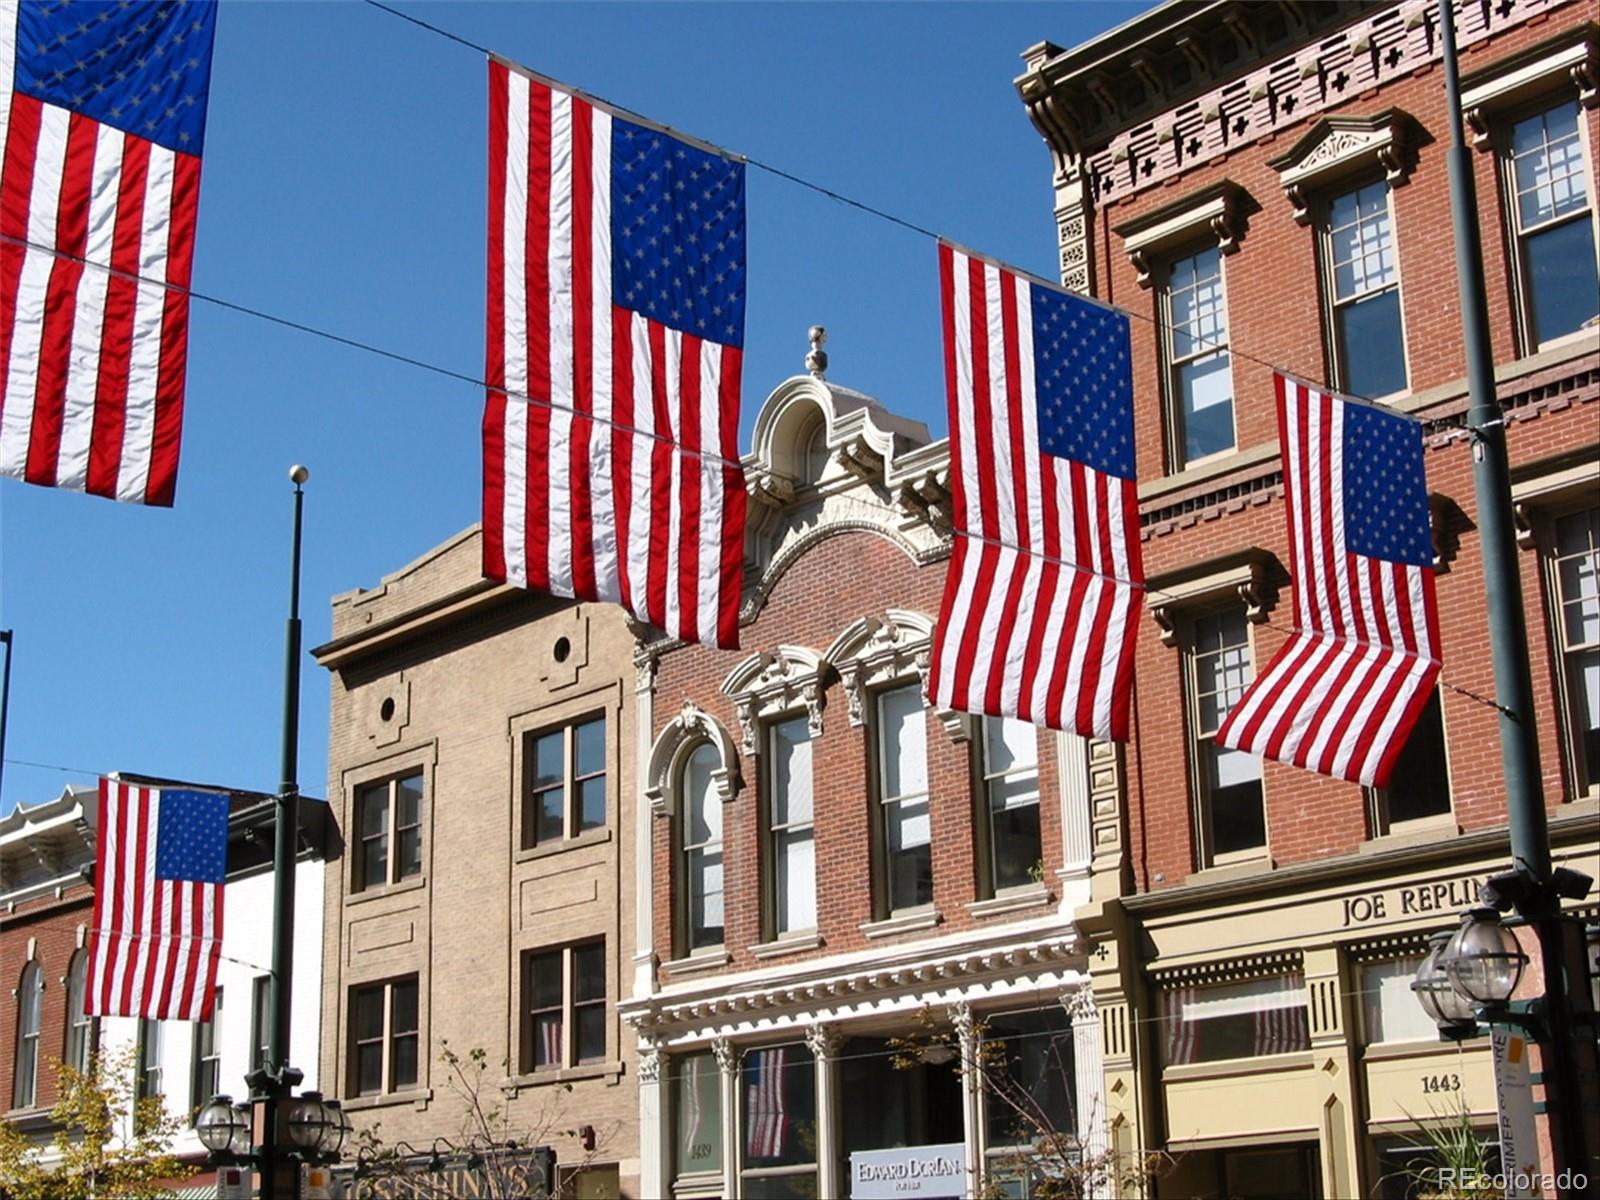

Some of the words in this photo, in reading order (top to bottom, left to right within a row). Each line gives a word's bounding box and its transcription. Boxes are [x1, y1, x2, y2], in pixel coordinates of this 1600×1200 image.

[1343, 894, 1386, 926] JOE
[1421, 1074, 1461, 1093] 1443
[858, 1163, 908, 1182] EDWARD
